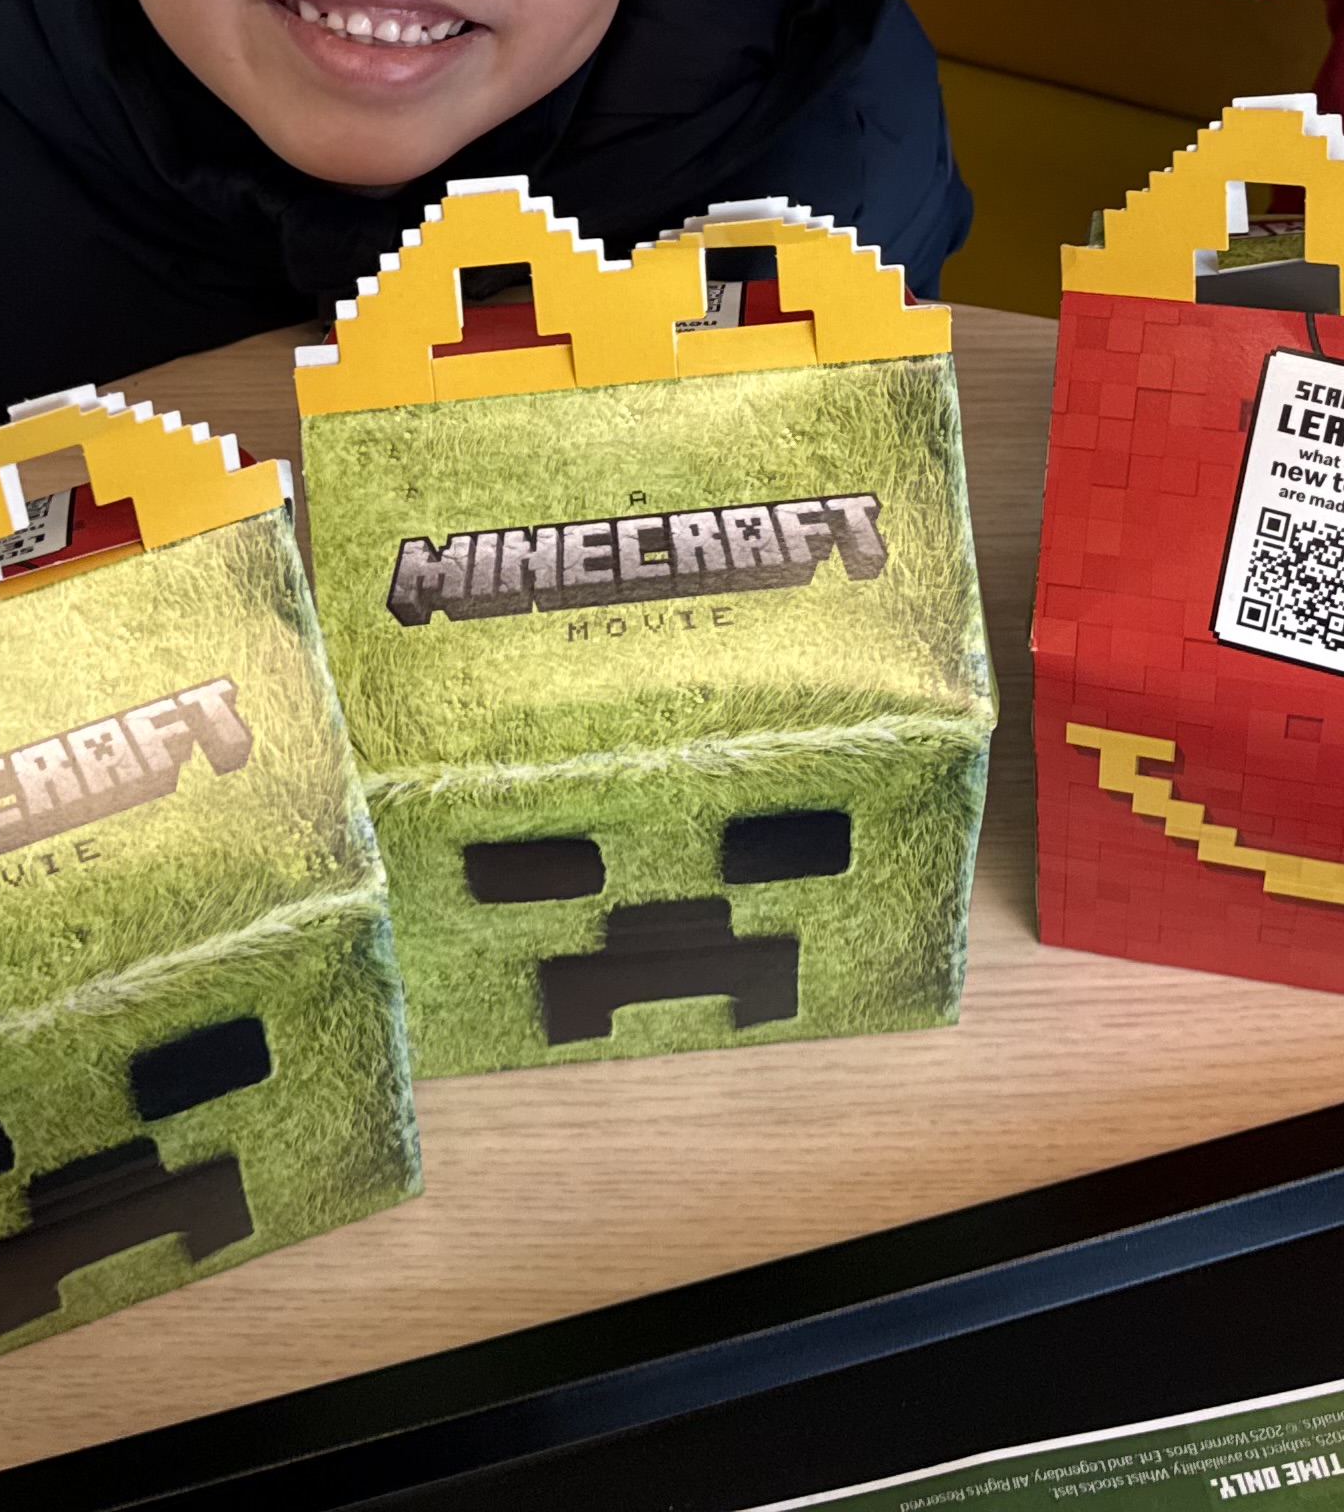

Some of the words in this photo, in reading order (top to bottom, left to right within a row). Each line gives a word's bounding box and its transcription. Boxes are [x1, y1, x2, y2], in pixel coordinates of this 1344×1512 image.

[1299, 449, 1341, 468] what
[1271, 460, 1327, 487] new
[629, 490, 647, 505] A
[1278, 487, 1306, 502] are
[386, 492, 888, 626] MINECRAFT
[567, 606, 734, 641] MOVIE
[1199, 1431, 1250, 1452] Warner
[1249, 1424, 1282, 1442] 2025
[1166, 1442, 1198, 1458] Bros.
[1245, 1448, 1261, 1461] to
[1265, 1434, 1312, 1459] subject
[1108, 1455, 1133, 1471] and
[1012, 1473, 1029, 1489] All
[1081, 1476, 1124, 1494] stocks
[1128, 1467, 1170, 1486] Whilst
[1209, 1466, 1282, 1500] ONLY.
[966, 1477, 1011, 1496] Rights
